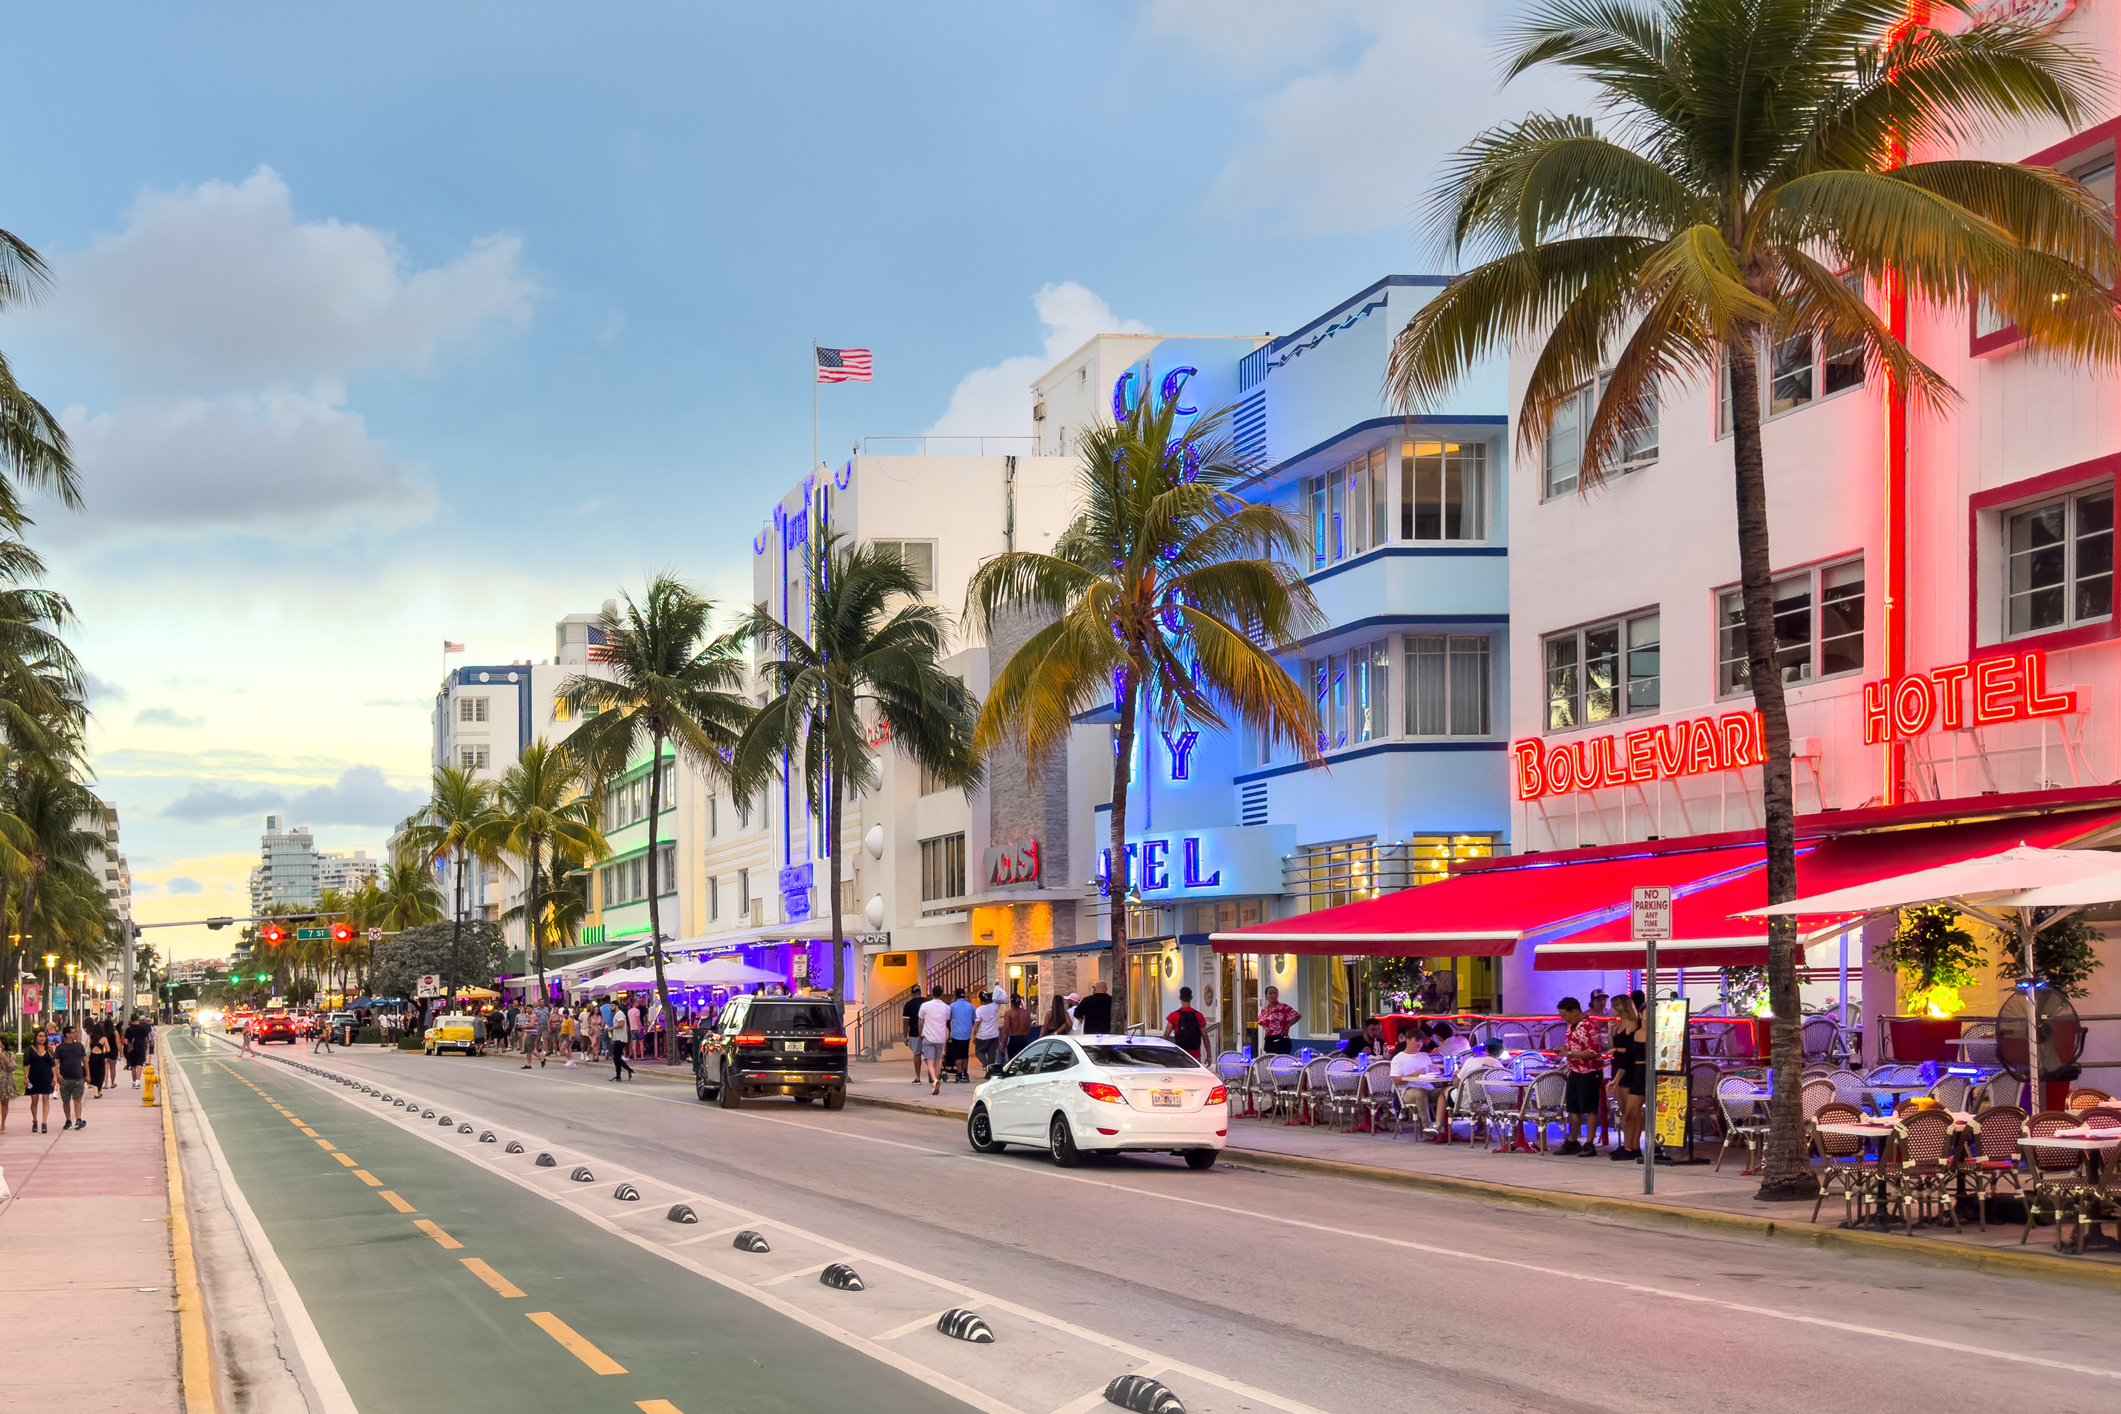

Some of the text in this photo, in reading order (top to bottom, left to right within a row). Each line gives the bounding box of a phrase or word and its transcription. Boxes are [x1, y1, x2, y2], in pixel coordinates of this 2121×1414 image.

[1864, 648, 2077, 746] HOTEL
[1644, 889, 1659, 899] NO
[1635, 900, 1668, 910] PARKING
[1645, 911, 1658, 919] ANY
[308, 930, 314, 938] 7
[865, 934, 887, 943] CVS
